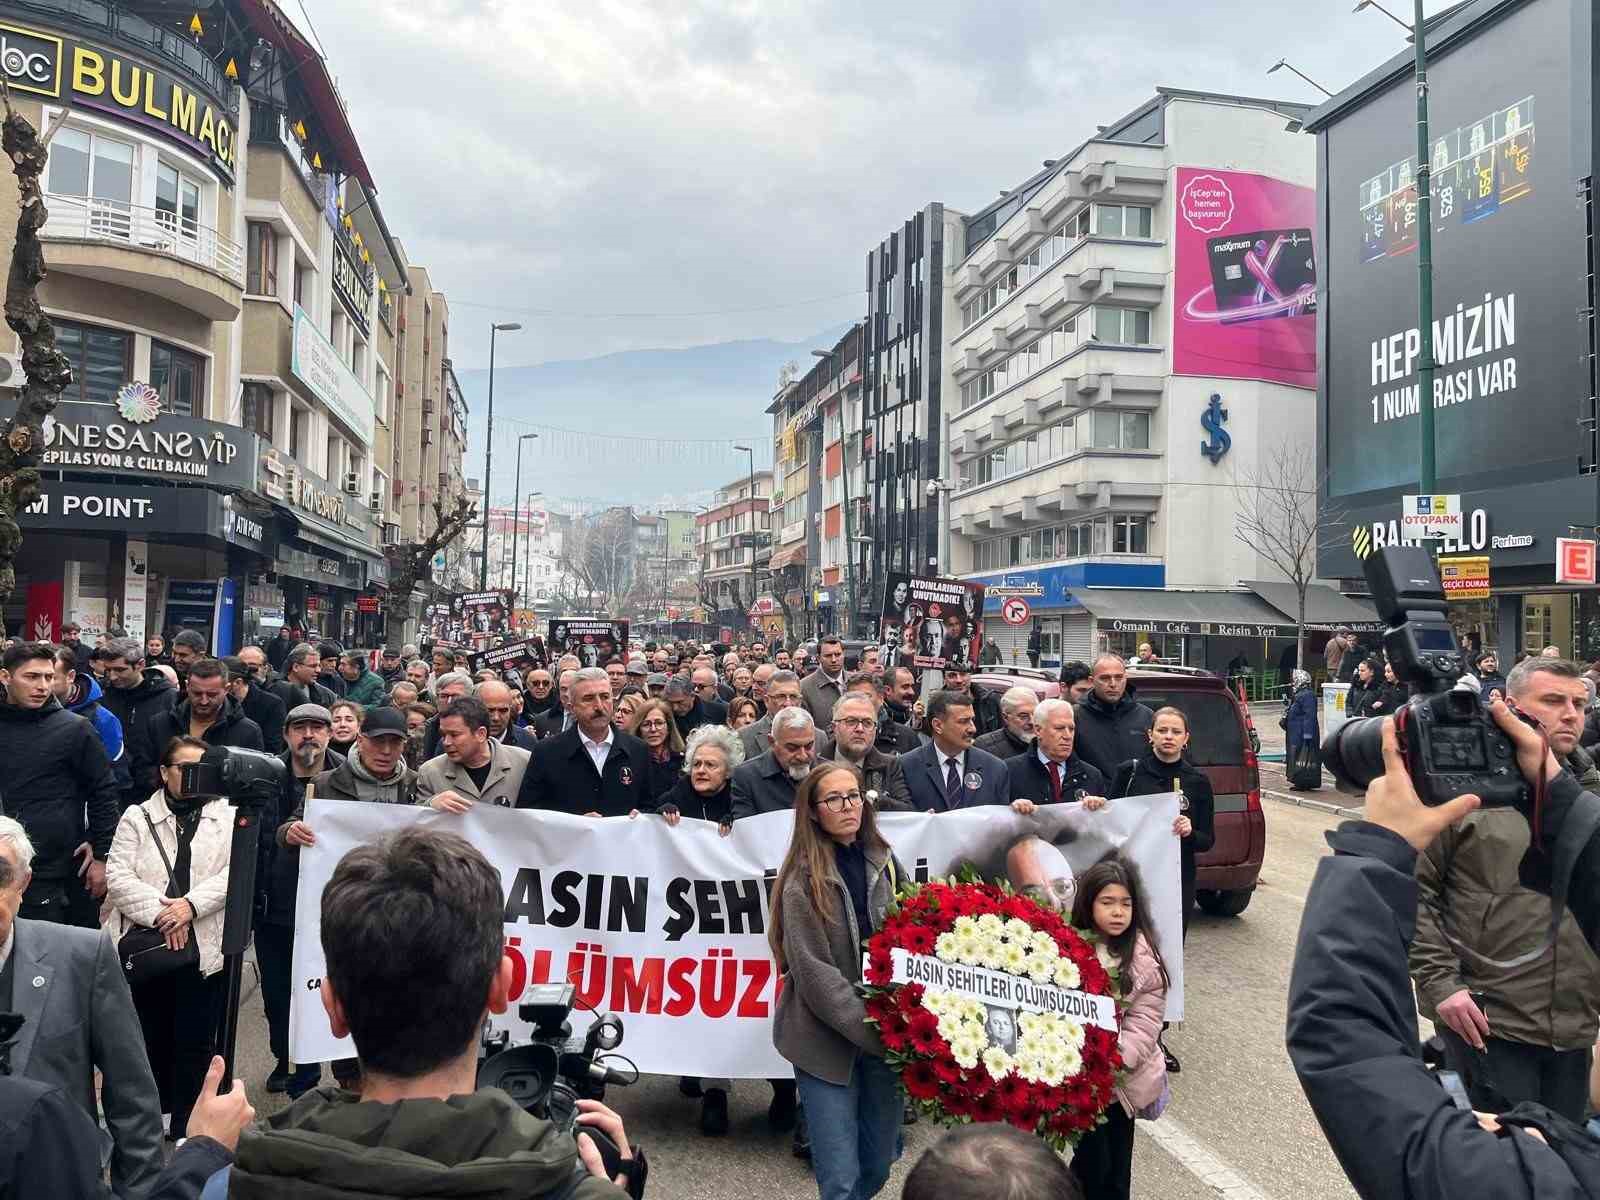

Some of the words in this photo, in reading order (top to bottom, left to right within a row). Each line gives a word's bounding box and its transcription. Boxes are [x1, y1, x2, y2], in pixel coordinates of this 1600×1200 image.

[1194, 200, 1221, 208] hemen
[1371, 292, 1515, 386] HEPMİZİN
[1371, 395, 1379, 424] 1
[1383, 368, 1473, 421] NUMRASI
[1478, 357, 1516, 398] VAR
[124, 456, 135, 469] &
[166, 461, 208, 477] BAKIMI
[1405, 515, 1459, 525] OTOPARK
[1491, 535, 1533, 549] Perfume
[1569, 548, 1587, 575] E
[909, 579, 966, 595] AYDINLARIMIZI
[1465, 580, 1489, 588] DURAK
[912, 590, 961, 605] UNUTMADIK!
[1113, 620, 1157, 632] Osmanlı
[1166, 622, 1190, 633] Cafe
[1256, 624, 1277, 636] Yeri
[503, 867, 649, 933] ASIN
[502, 936, 785, 1018] ÖLÜMSÜZ
[906, 957, 943, 985] BASIN
[947, 967, 1011, 1001] ŞEHİTLERİ
